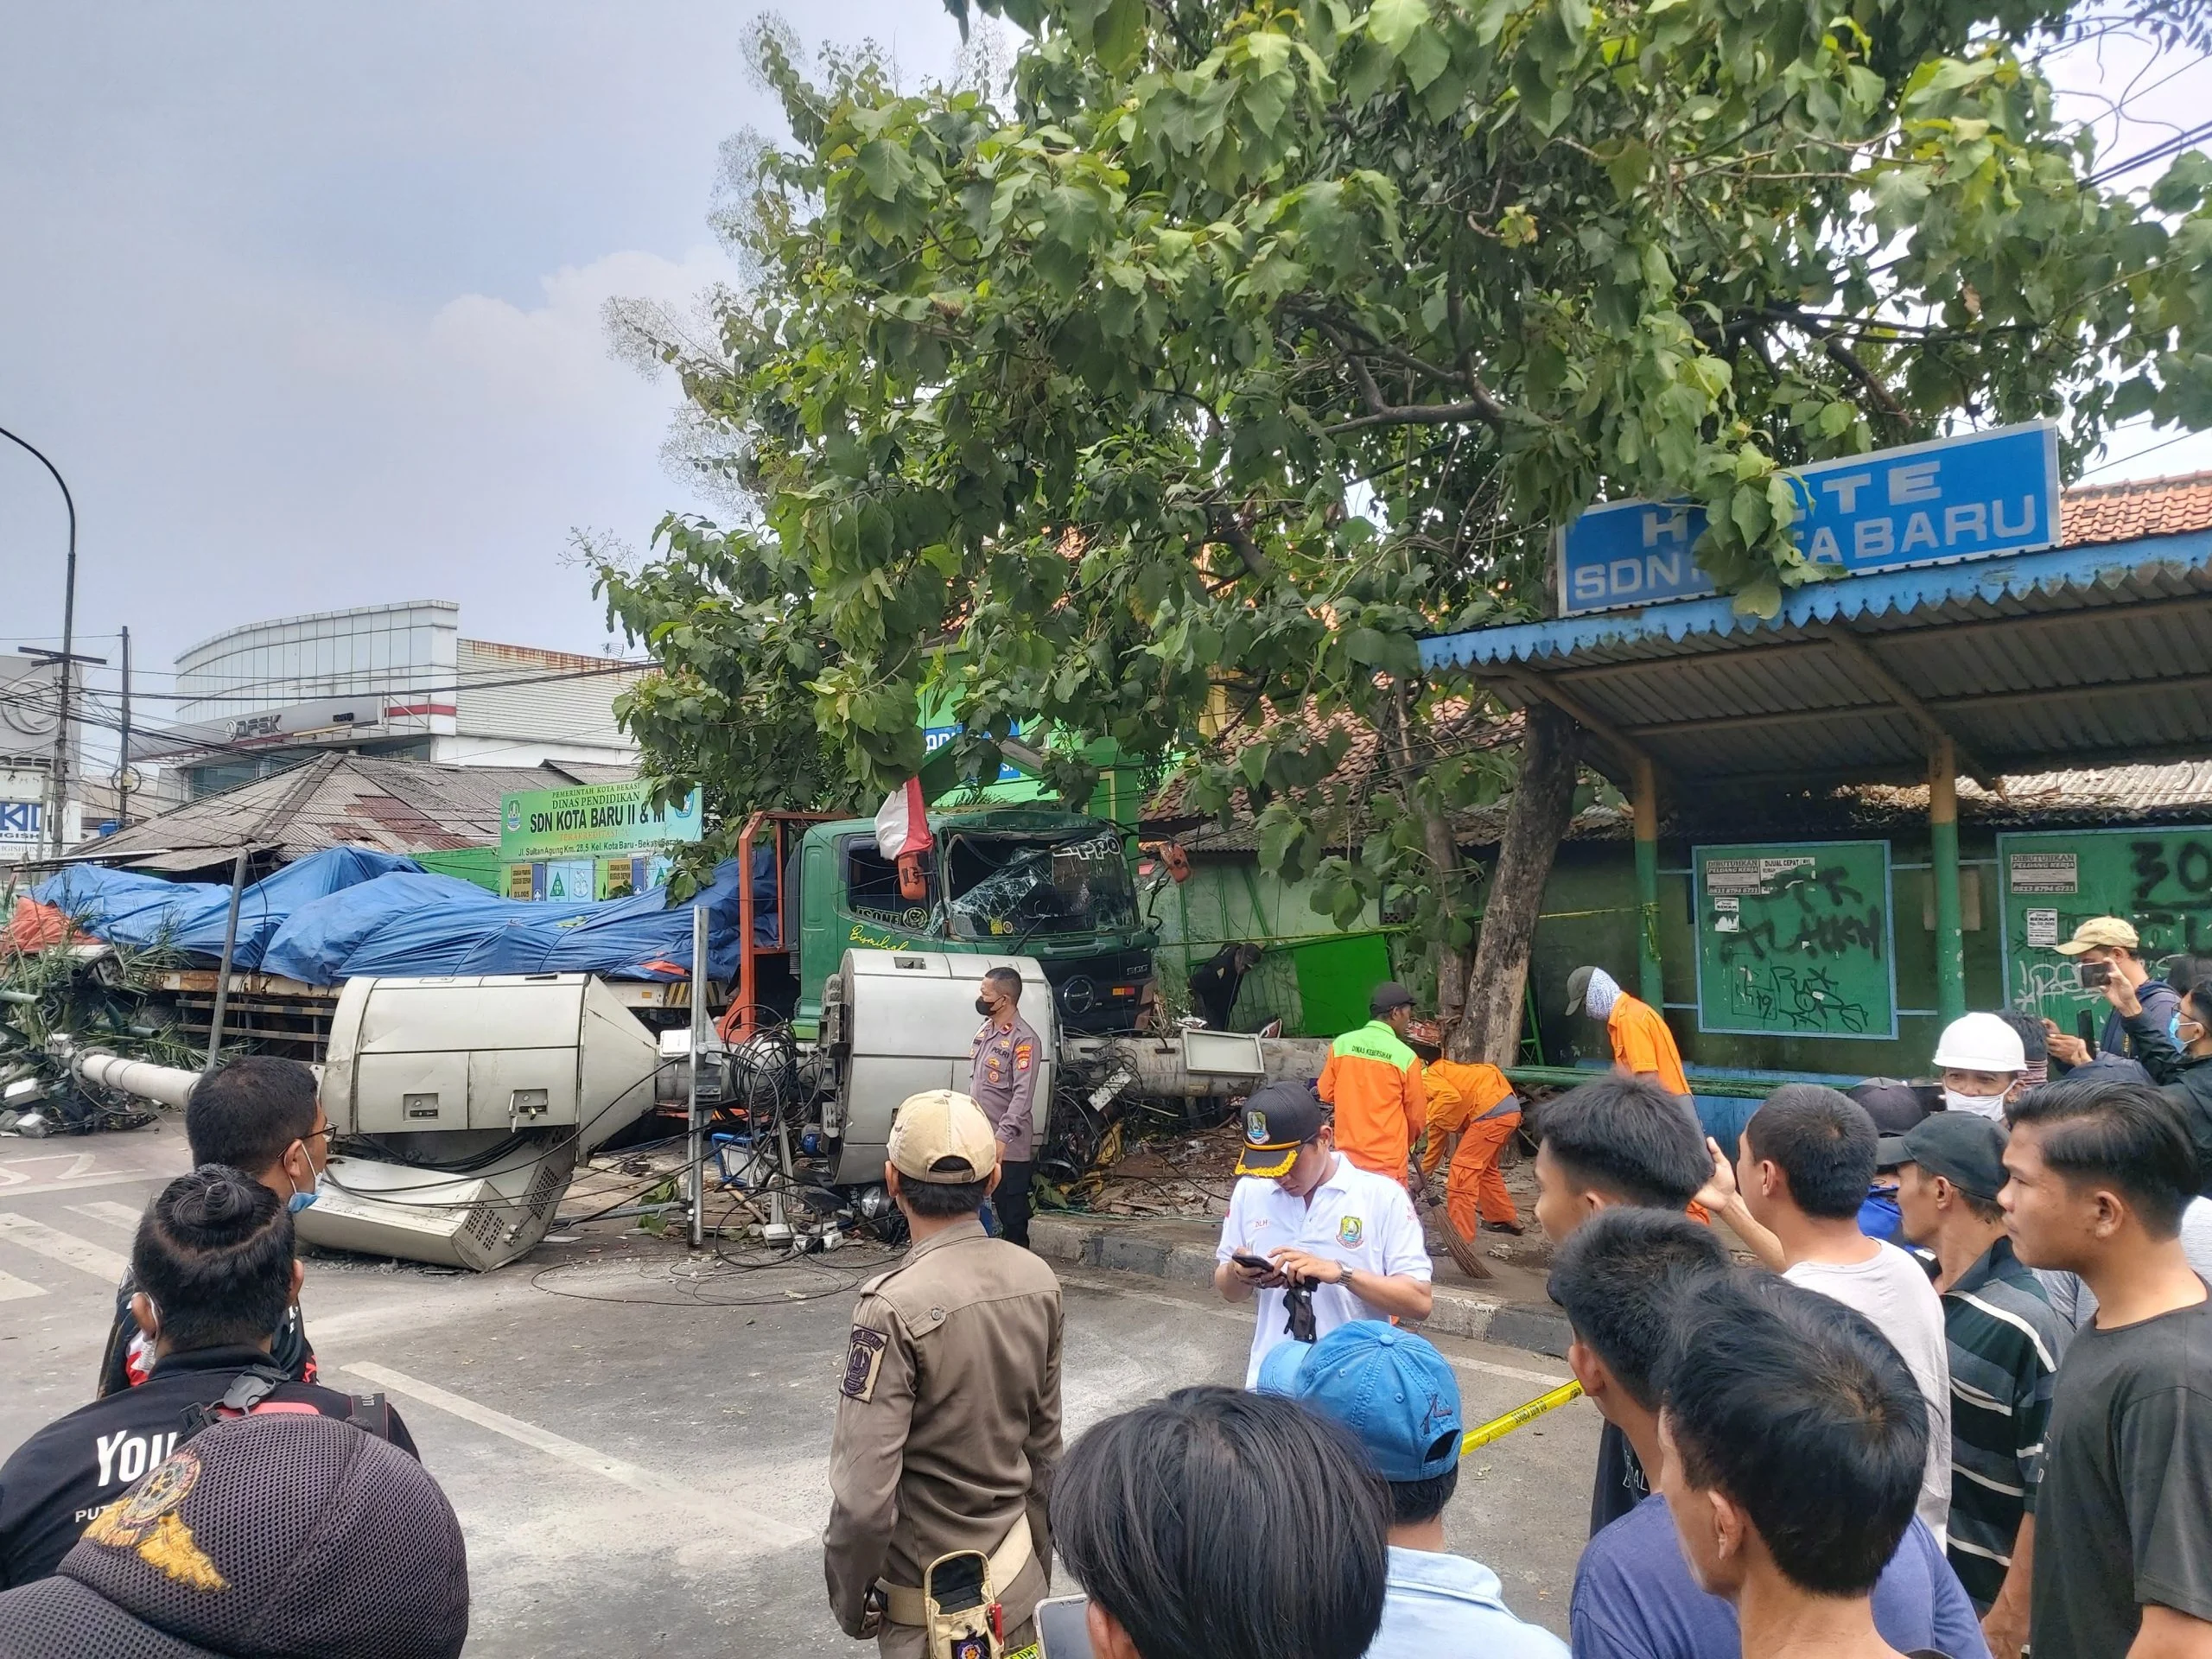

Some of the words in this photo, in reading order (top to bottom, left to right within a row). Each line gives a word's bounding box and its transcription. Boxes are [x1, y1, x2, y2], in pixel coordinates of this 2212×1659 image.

[1643, 461, 1942, 548] HTE
[1573, 555, 1681, 601] SDN
[552, 787, 594, 798] PEMERINTAH
[552, 798, 580, 809] DINAS
[581, 791, 641, 807] PENDIDIKAN
[530, 811, 553, 833] SDN
[556, 809, 588, 831] KOTA
[590, 804, 624, 829] BARU
[627, 804, 635, 825] II
[639, 803, 649, 823] &
[544, 846, 563, 856] Agung
[591, 842, 603, 851] Kel.
[605, 842, 619, 850] Kota
[619, 841, 634, 849] Baru
[991, 1046, 1010, 1058] POLRI
[1255, 1219, 1268, 1228] DLH
